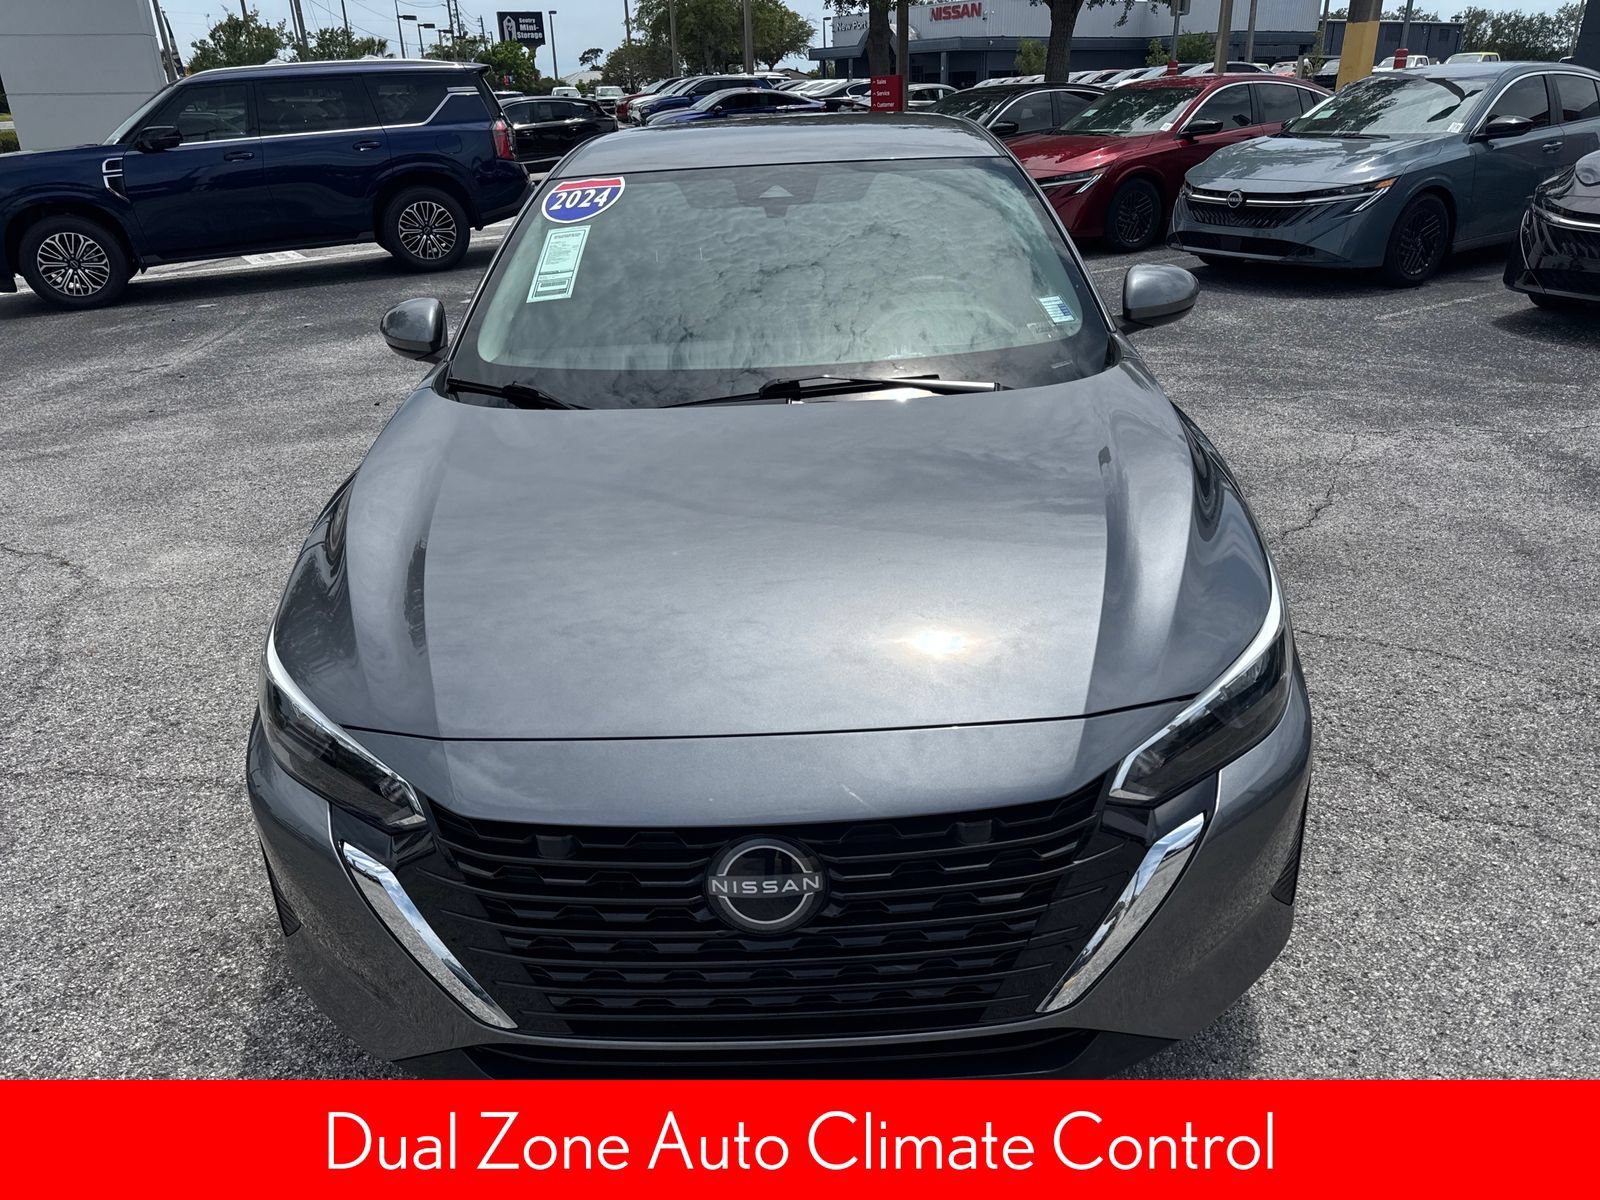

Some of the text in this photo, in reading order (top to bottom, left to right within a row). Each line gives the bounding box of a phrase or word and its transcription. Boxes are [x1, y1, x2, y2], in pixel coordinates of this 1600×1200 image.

[929, 2, 982, 21] NISSAN
[516, 31, 543, 39] Storage
[836, 20, 869, 31] New Port
[548, 187, 612, 211] 2024
[711, 875, 820, 894] NISSAN
